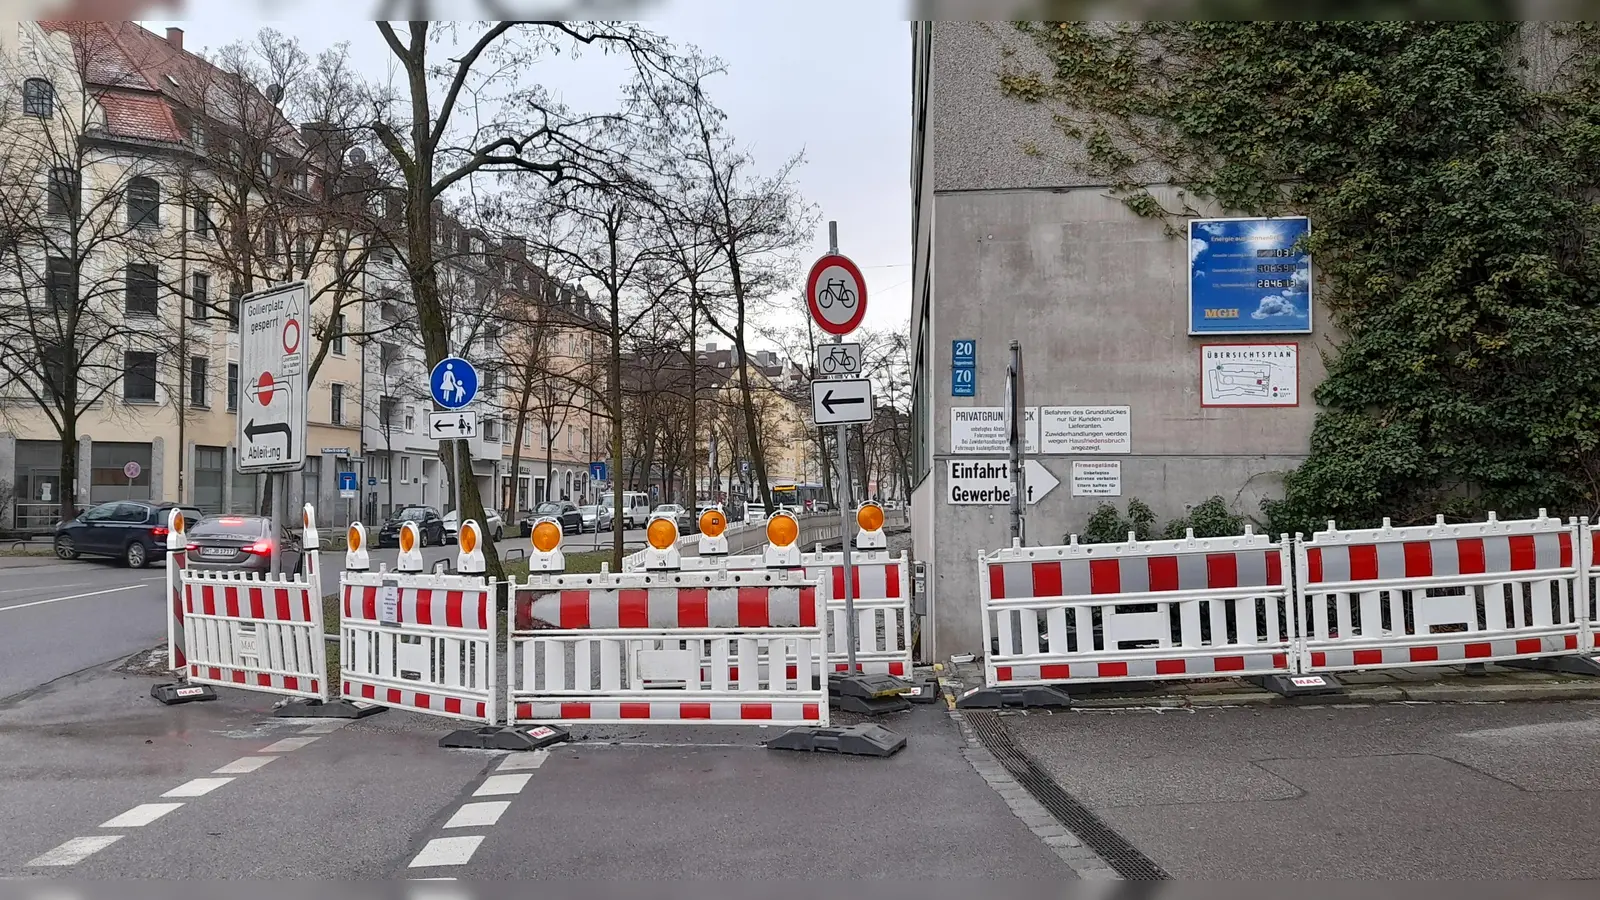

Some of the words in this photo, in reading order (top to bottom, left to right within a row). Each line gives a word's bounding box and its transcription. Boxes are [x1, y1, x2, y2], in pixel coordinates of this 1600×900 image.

[248, 300, 284, 316] Gollierplatz
[1204, 308, 1239, 318] MGH
[251, 316, 278, 335] gesperrt
[956, 342, 972, 355] 20
[1207, 351, 1291, 359] ÜBERSICHTSPLAN
[956, 370, 971, 382] 70
[952, 463, 1008, 479] Einfahrt
[952, 486, 1033, 502] Gewerbef
[531, 728, 552, 736] MAC
